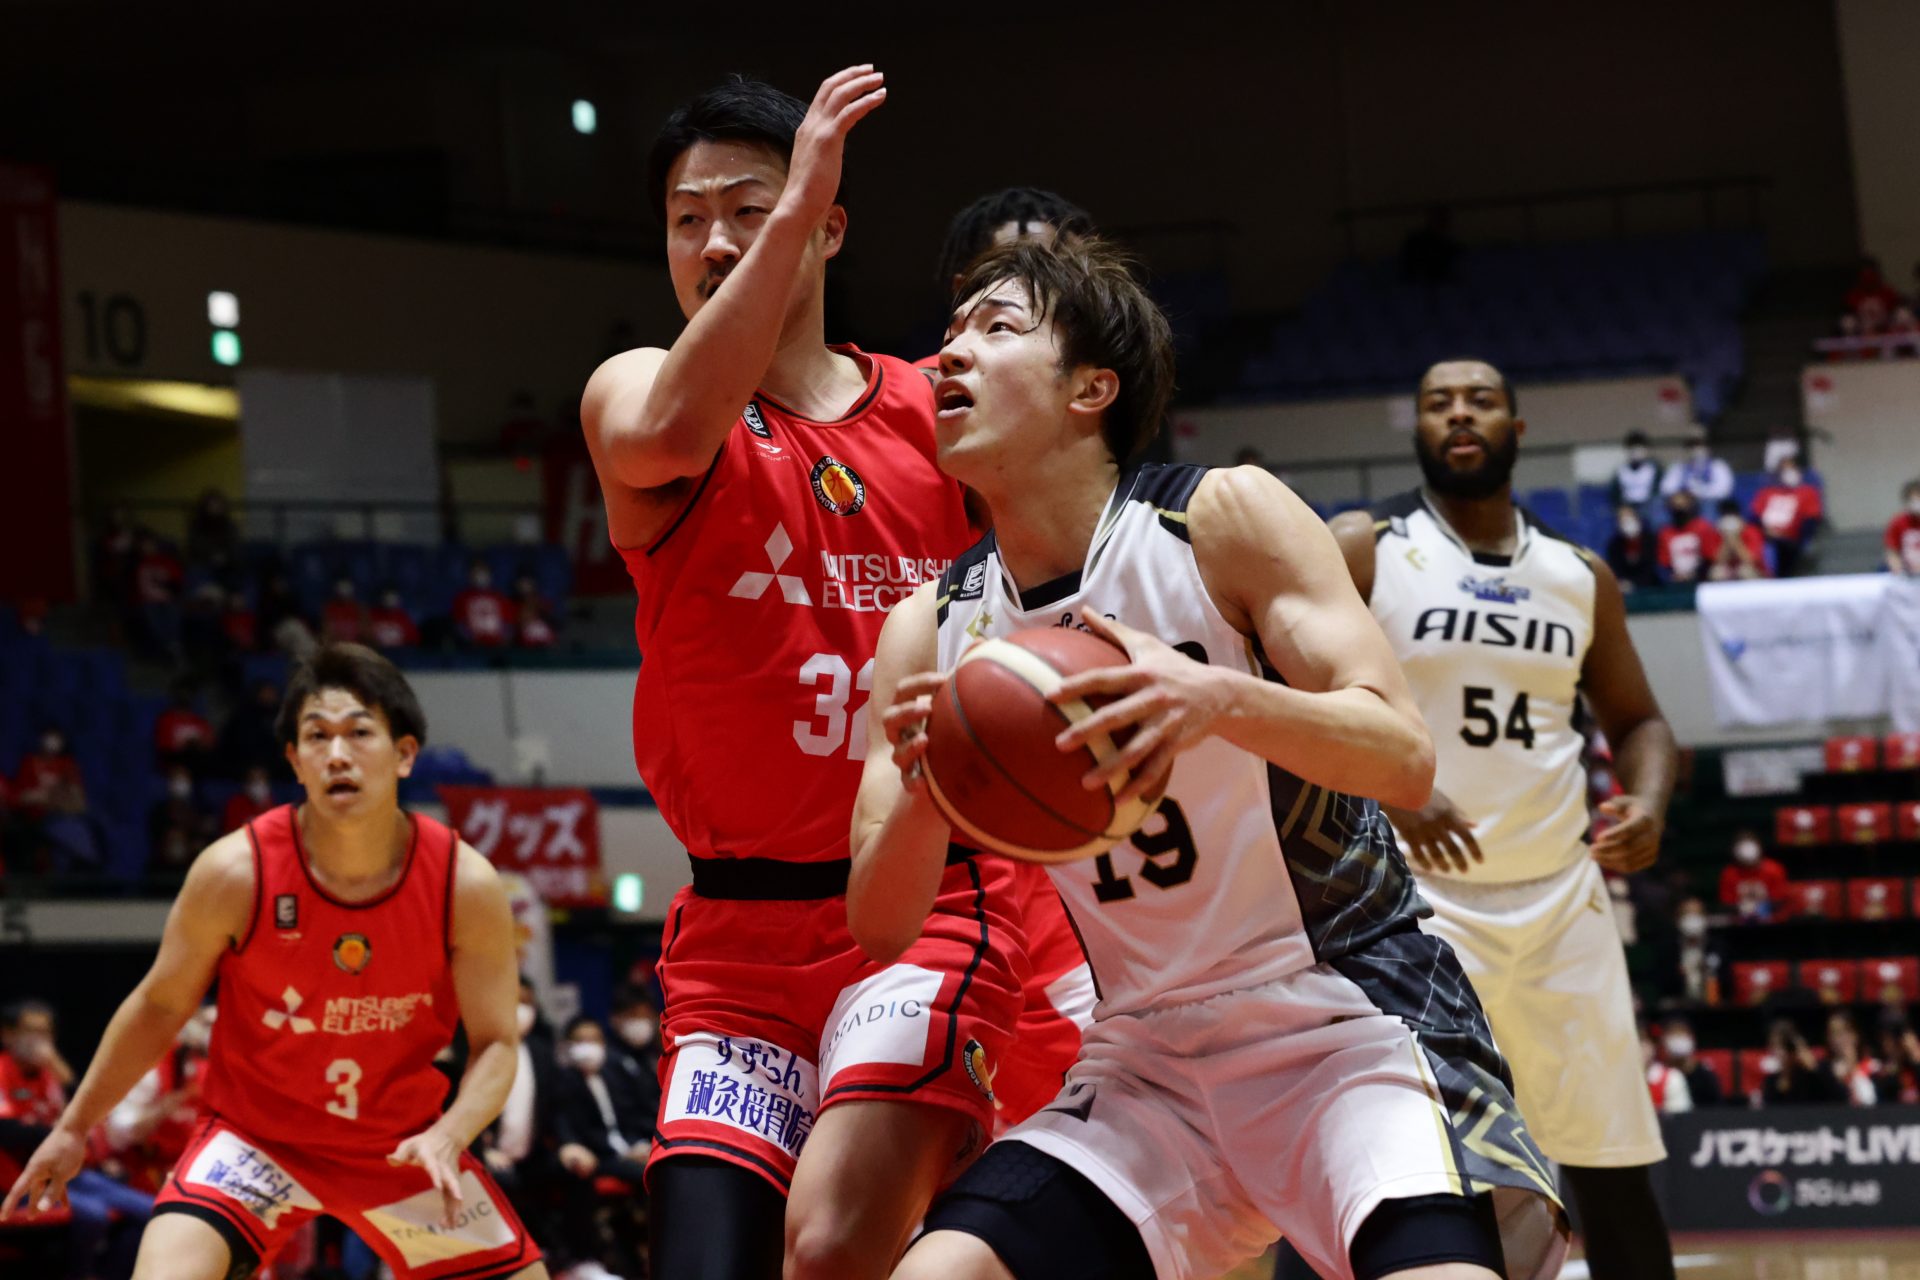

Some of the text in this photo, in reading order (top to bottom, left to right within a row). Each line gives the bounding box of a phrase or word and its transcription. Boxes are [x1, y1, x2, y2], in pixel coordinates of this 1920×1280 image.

[78, 289, 145, 368] 10
[822, 581, 921, 613] ELECT
[1413, 607, 1574, 658] AISIN
[1459, 685, 1535, 750] 54
[463, 798, 585, 862] グッズ
[1090, 794, 1199, 904] 19
[324, 1058, 363, 1121] 3
[715, 1036, 805, 1099] すずらん
[685, 1069, 816, 1158] 鍼灸接骨院
